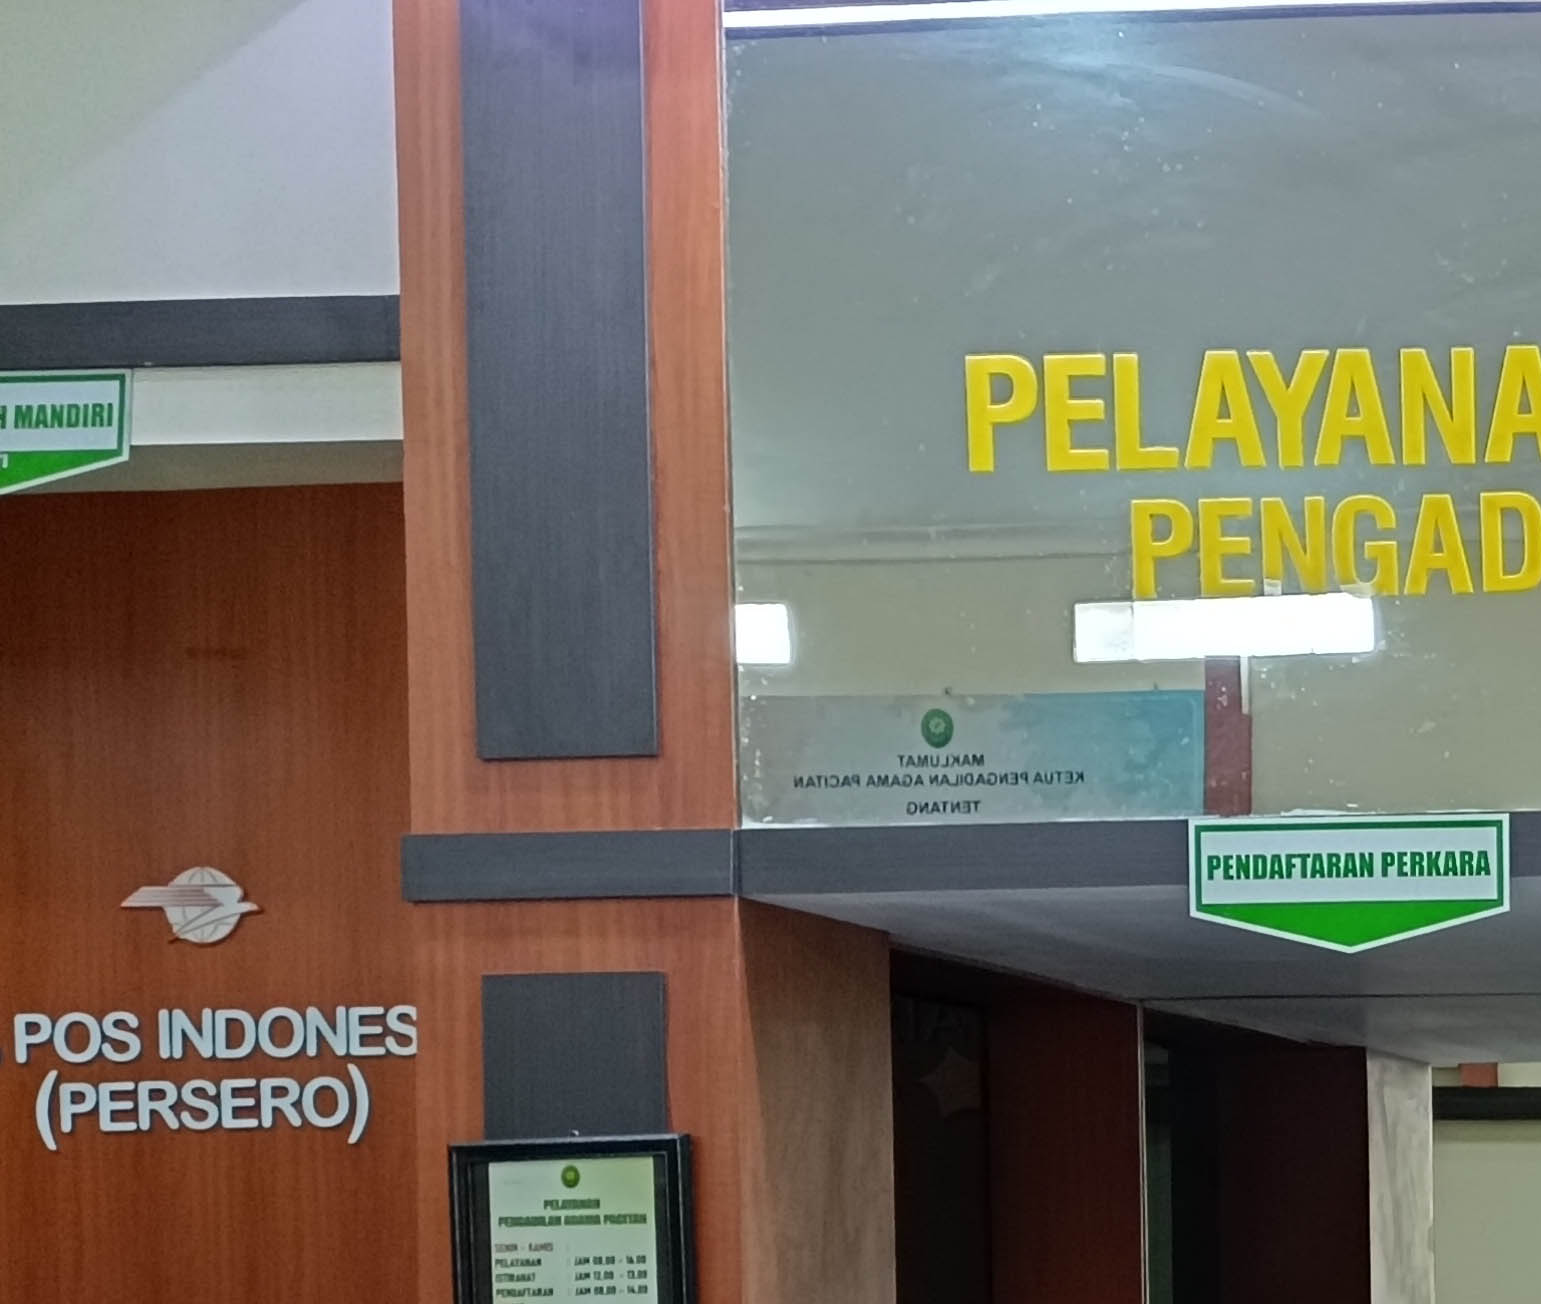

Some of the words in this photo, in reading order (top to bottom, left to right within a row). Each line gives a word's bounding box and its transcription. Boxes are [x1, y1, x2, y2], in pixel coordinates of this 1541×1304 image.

[14, 402, 114, 429] MANDIRI
[1207, 852, 1374, 880] PENDAFTARAN
[1381, 850, 1491, 877] PERKARA
[13, 1010, 142, 1064] POS
[158, 1004, 418, 1059] INDONES
[35, 1063, 370, 1151] (PERSERO)
[603, 1213, 648, 1225] PACITAN
[574, 1256, 590, 1266] JAM
[574, 1271, 591, 1281] JAM
[575, 1286, 591, 1296] JAM
